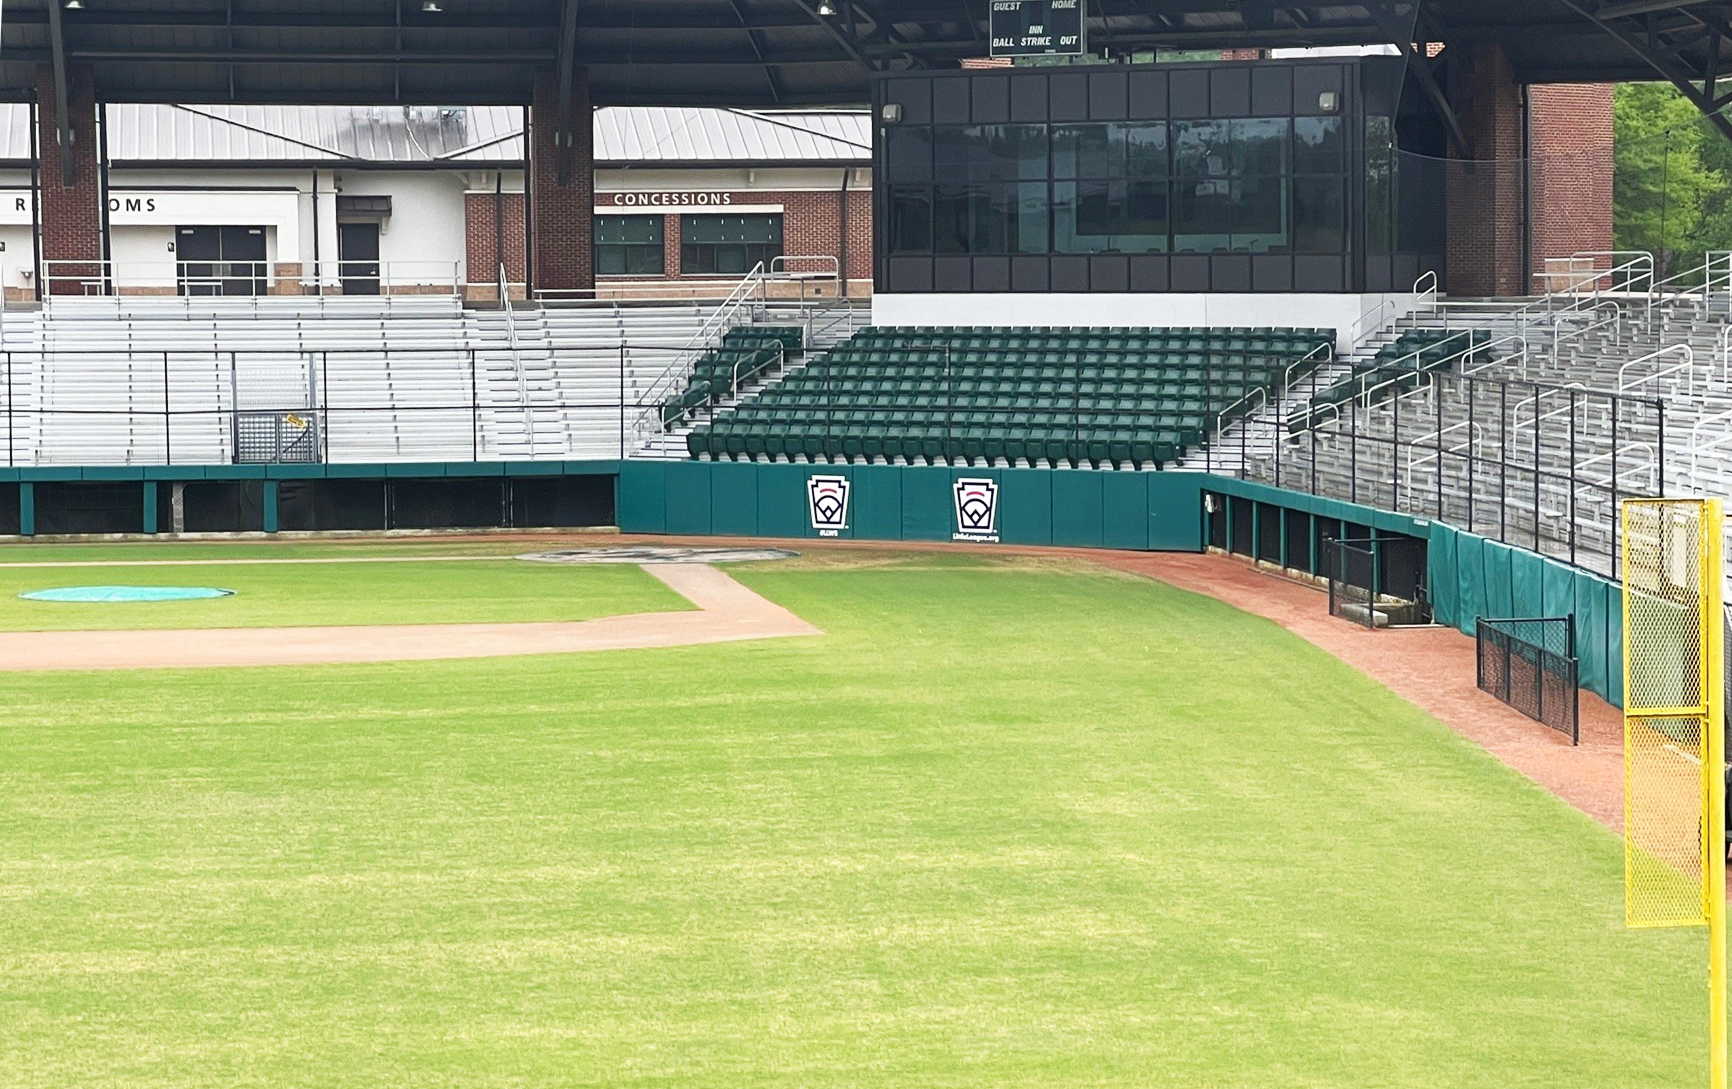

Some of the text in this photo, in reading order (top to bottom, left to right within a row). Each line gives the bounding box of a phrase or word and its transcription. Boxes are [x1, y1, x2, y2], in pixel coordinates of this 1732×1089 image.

[994, 0, 1077, 11] GUEST HOME
[1029, 25, 1043, 34] INN
[993, 36, 1077, 47] BALL STRIKE OUT
[614, 193, 731, 206] CONCESSIONS
